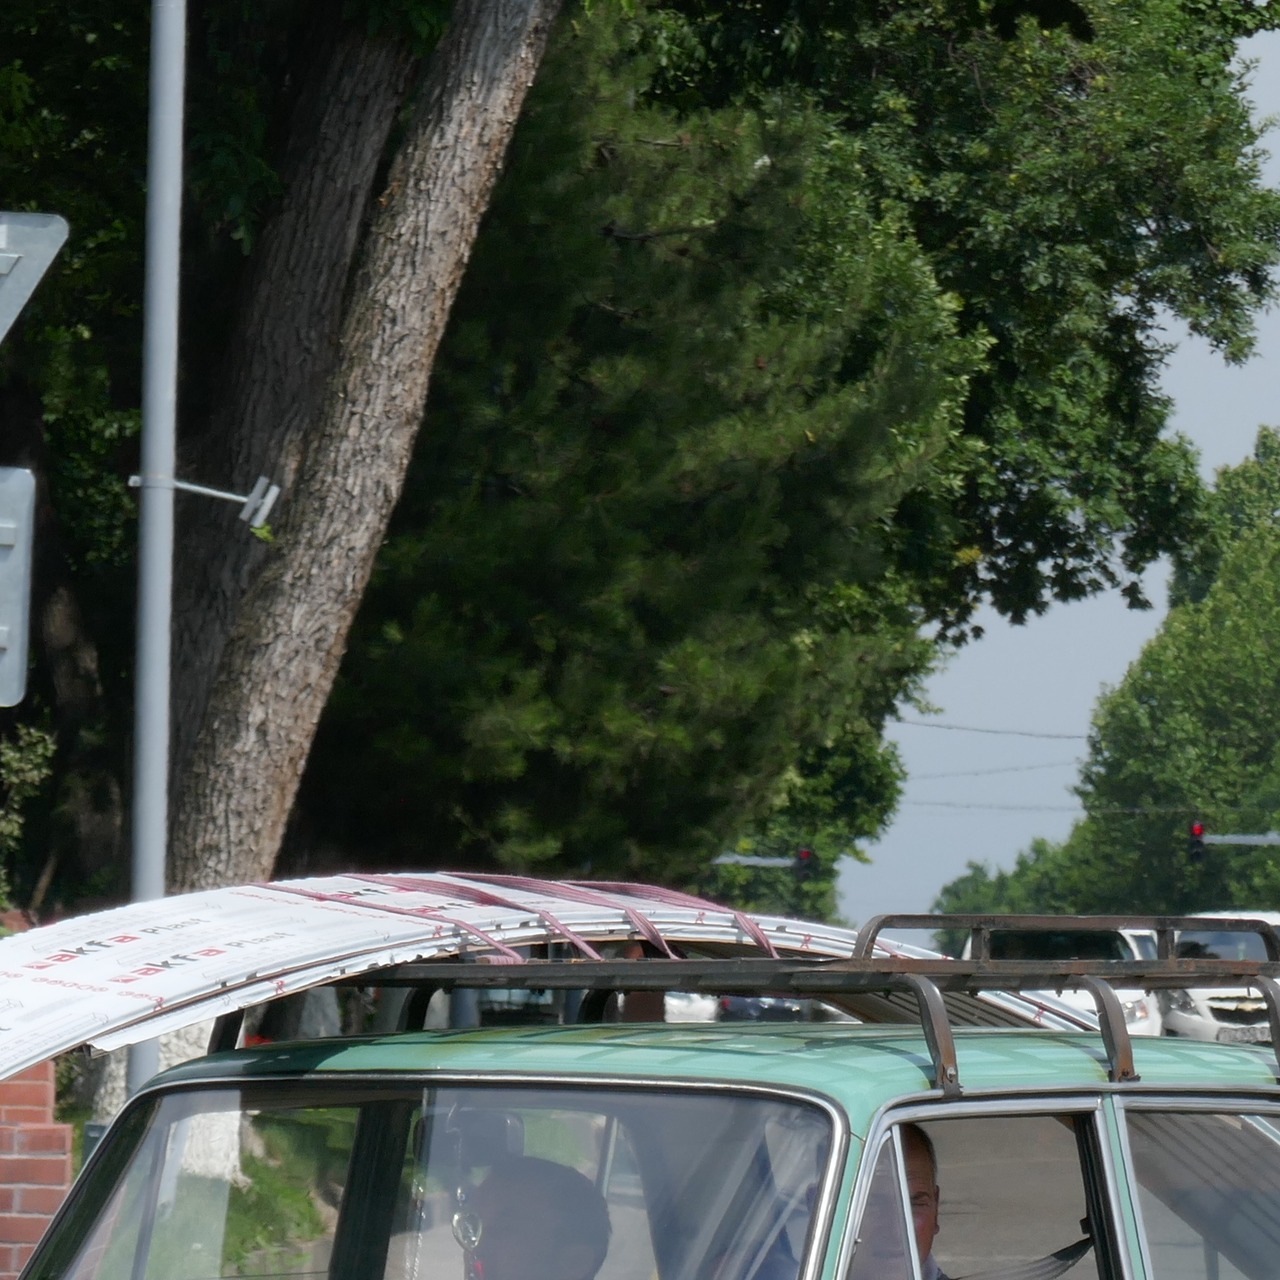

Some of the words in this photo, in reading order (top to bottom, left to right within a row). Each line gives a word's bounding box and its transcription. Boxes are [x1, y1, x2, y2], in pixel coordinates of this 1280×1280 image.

[44, 935, 142, 963] akfa
[139, 917, 211, 935] Plast
[130, 948, 227, 977] akfa
